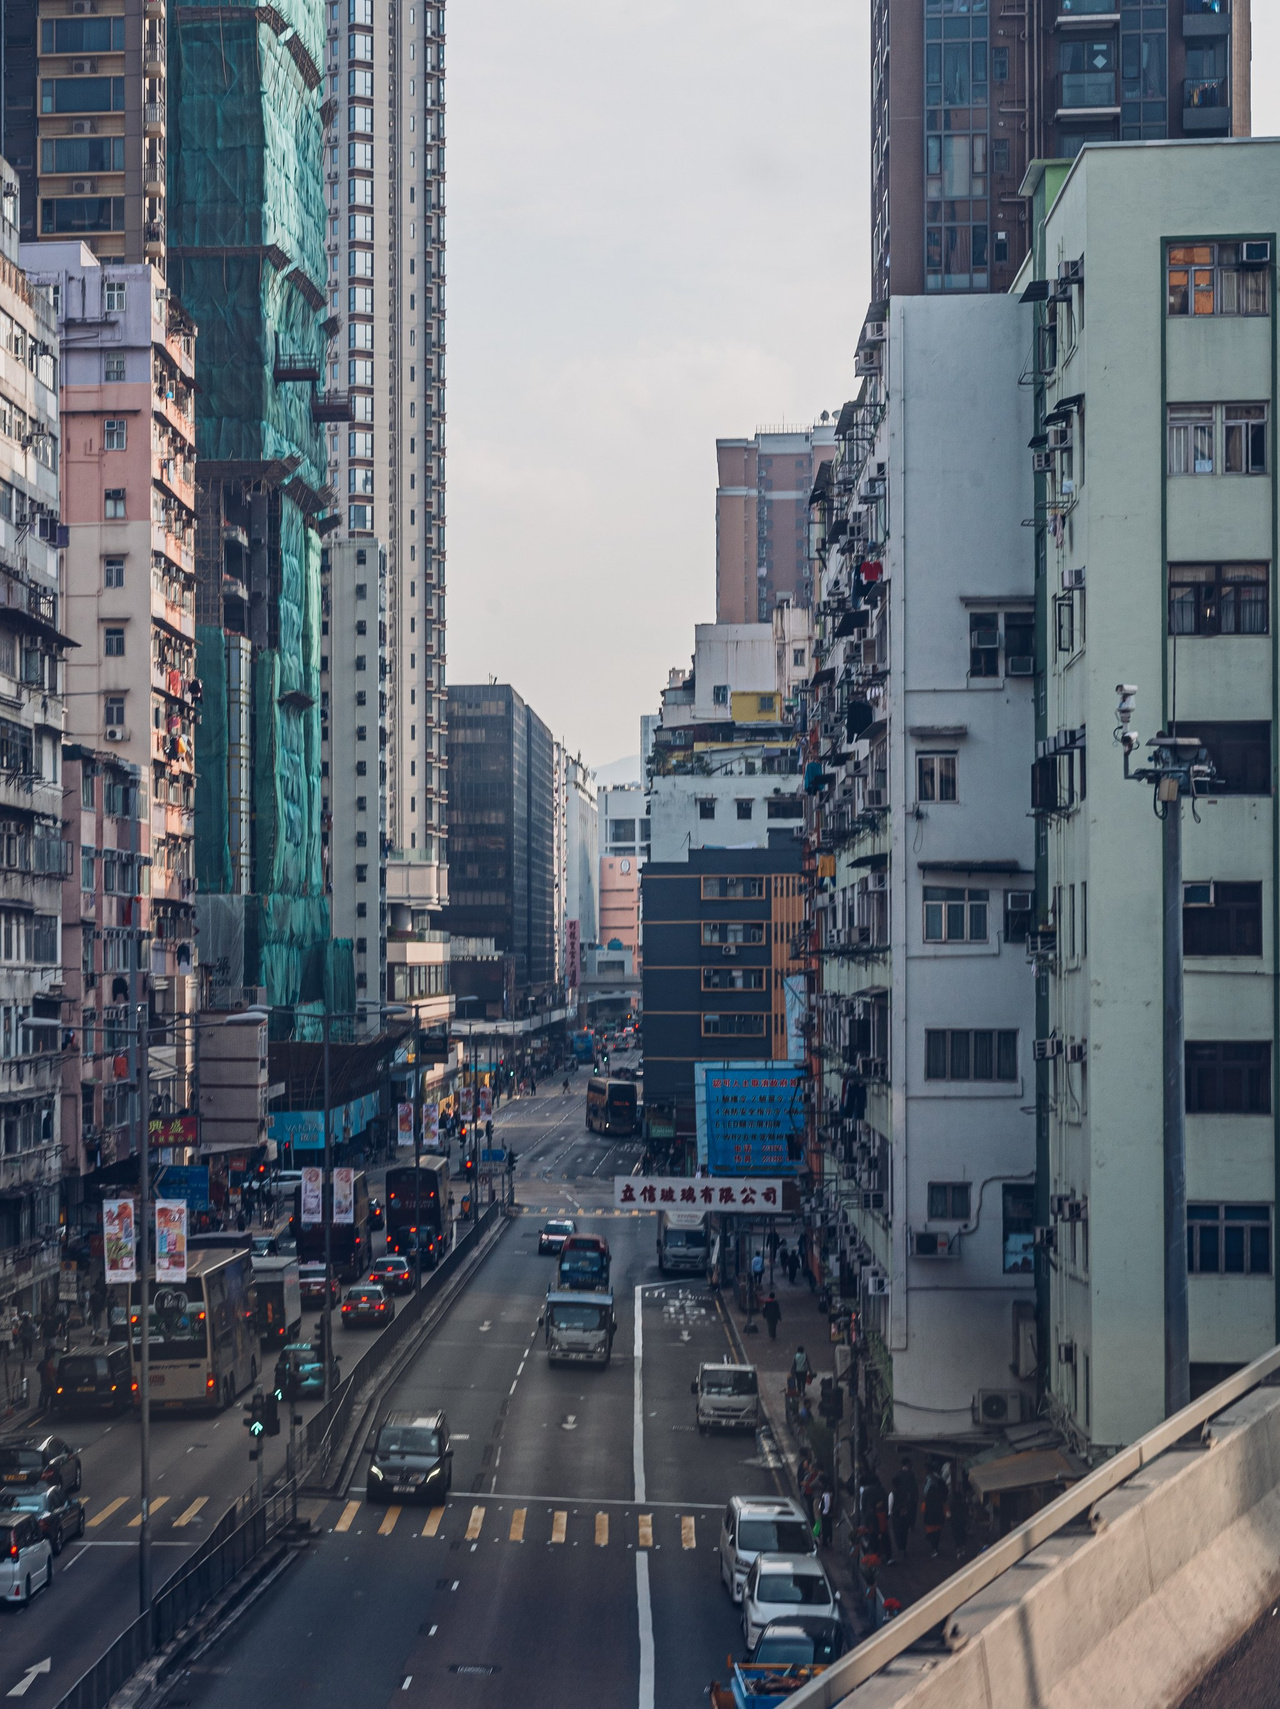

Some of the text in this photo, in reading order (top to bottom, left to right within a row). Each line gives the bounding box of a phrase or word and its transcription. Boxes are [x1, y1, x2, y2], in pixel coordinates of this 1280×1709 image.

[620, 1183, 778, 1205] 立信玻璃有限公司
